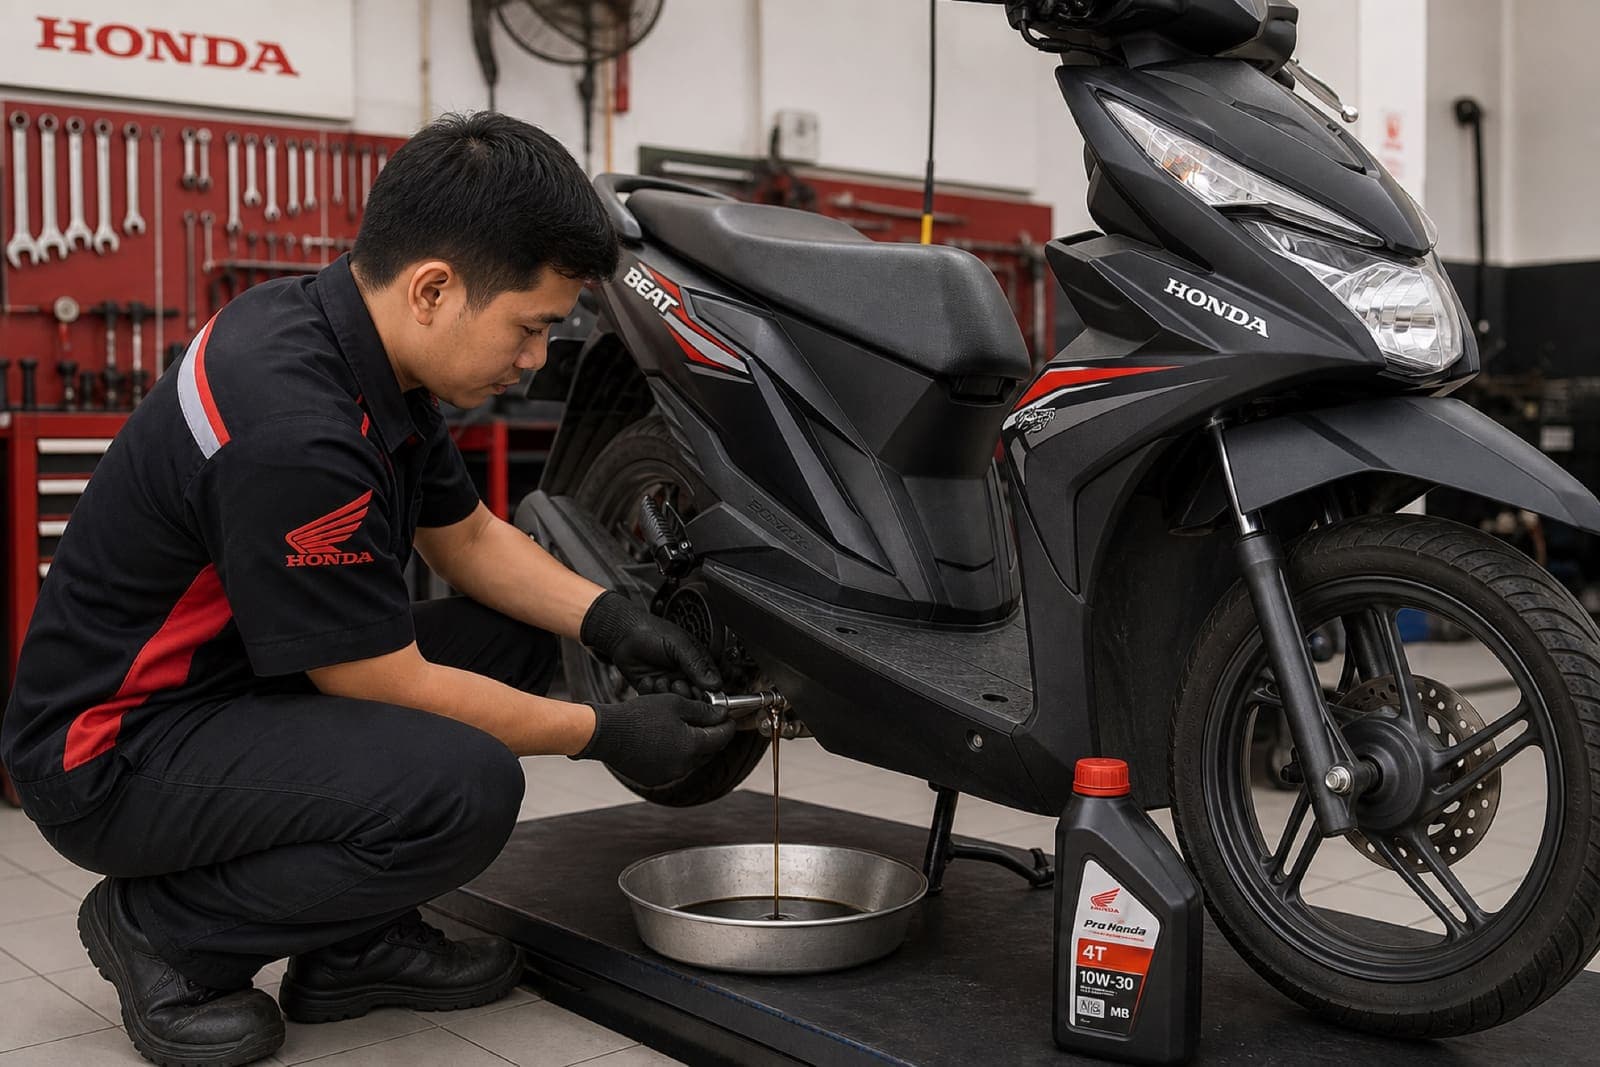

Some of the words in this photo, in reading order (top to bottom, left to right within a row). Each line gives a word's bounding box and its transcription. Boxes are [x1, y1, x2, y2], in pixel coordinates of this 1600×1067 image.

[36, 16, 299, 77] HONDA
[624, 267, 679, 312] BEAT
[1164, 278, 1269, 338] HONDA
[286, 552, 374, 567] HONDA
[1082, 945, 1107, 961] 4T
[1080, 971, 1134, 990] 10W-30
[1110, 1006, 1130, 1018] MB
